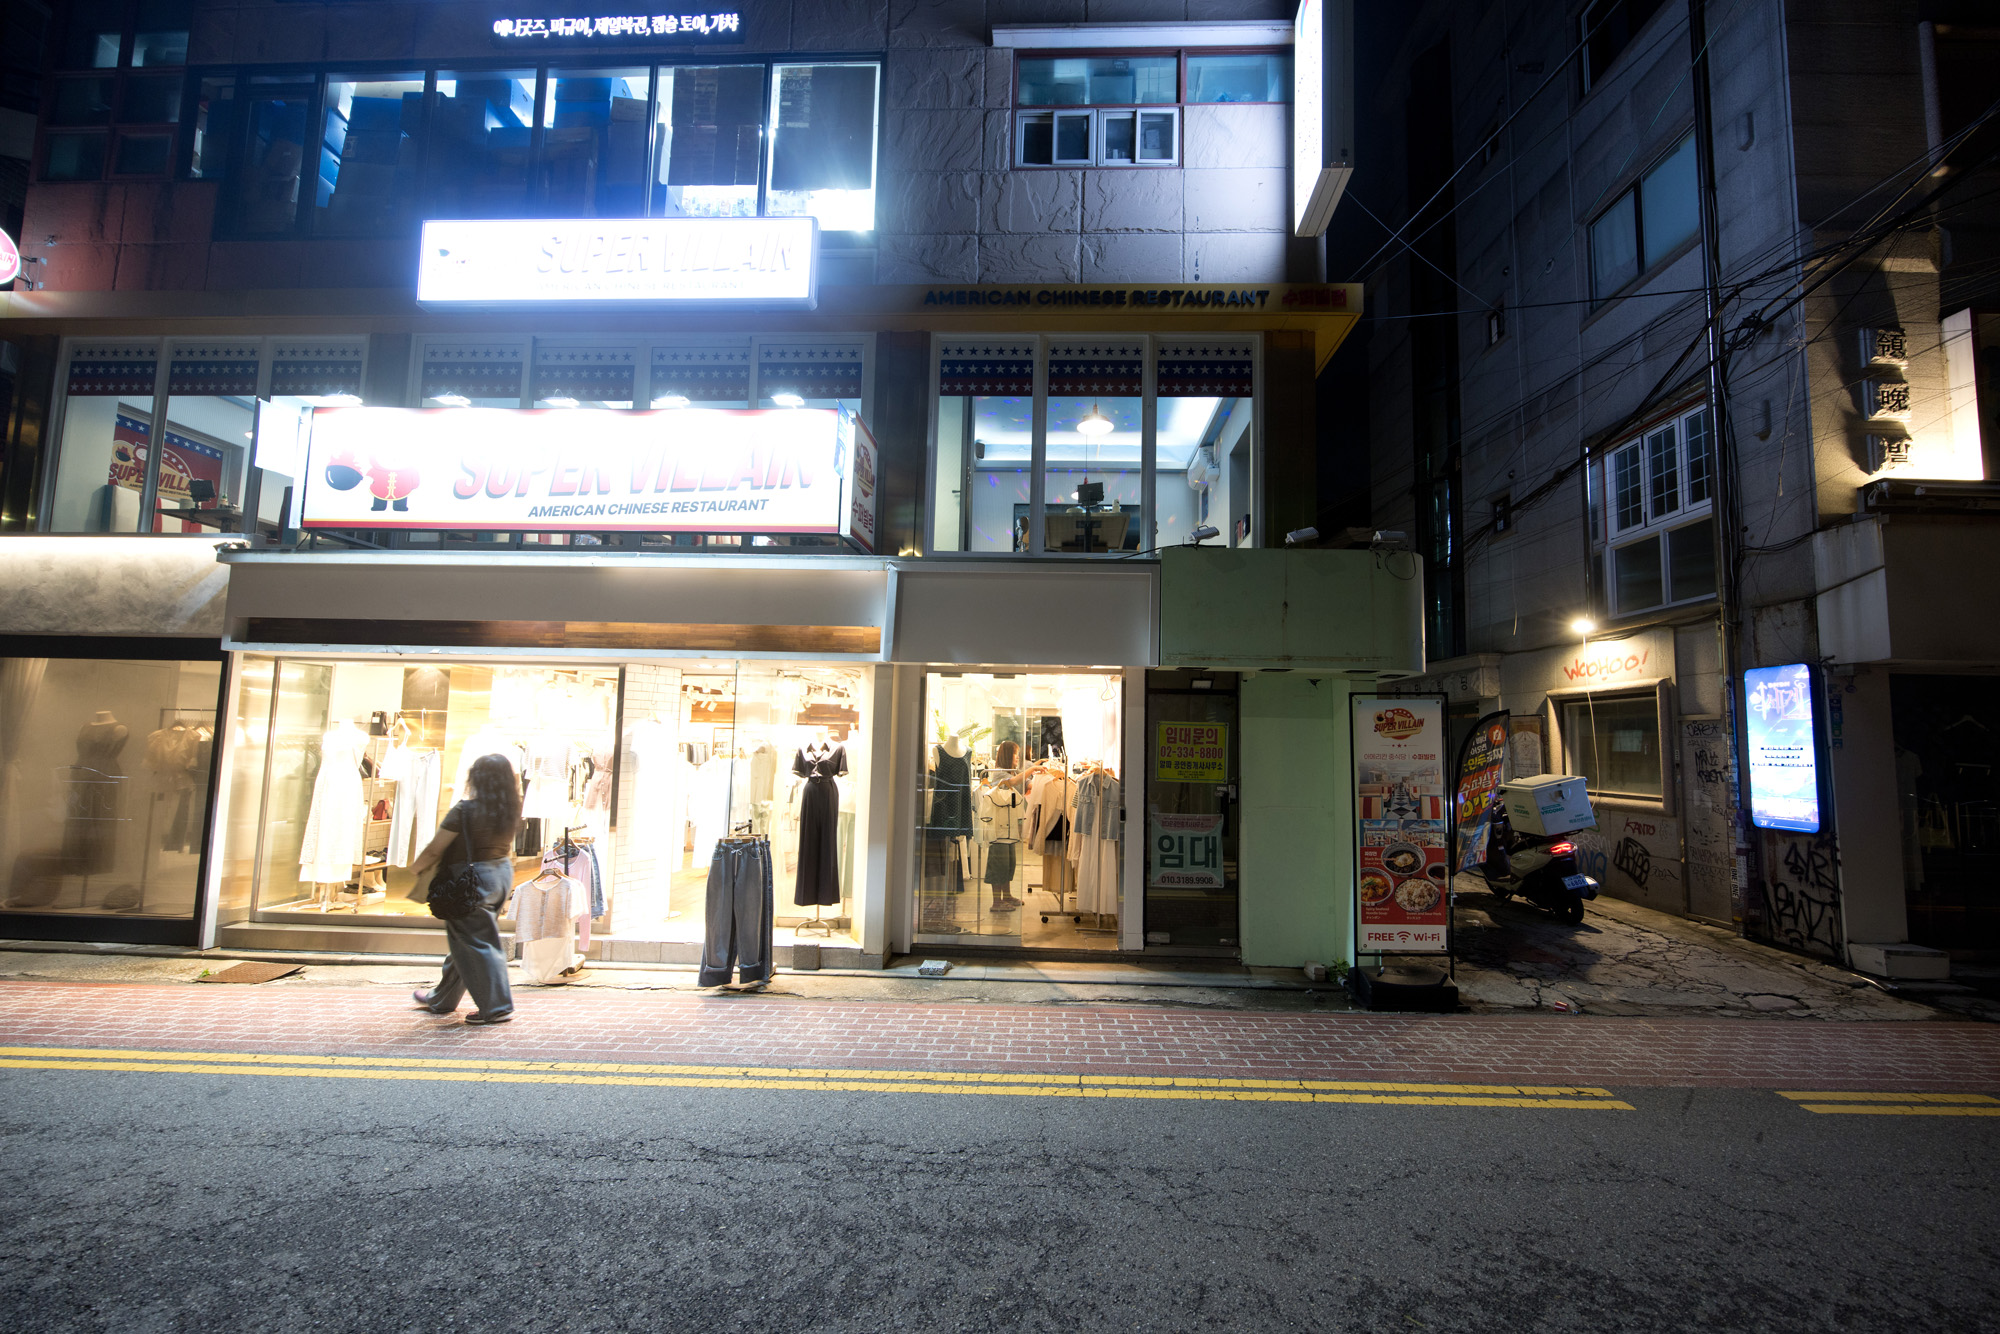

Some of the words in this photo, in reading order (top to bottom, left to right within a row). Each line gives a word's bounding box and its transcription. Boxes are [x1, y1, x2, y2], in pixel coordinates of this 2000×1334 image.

[924, 290, 1030, 306] AMERICAN
[1037, 290, 1127, 306] CHINESE
[1132, 289, 1269, 307] RESTAURANT
[108, 463, 145, 483] SUPE
[453, 448, 614, 499] SUPER
[630, 439, 813, 496] VILLAIN
[528, 502, 605, 517] AMERICAN
[607, 501, 670, 515] CHINESE
[671, 499, 769, 514] RESTAURANT
[1563, 651, 1648, 680] WOOHOO!
[1374, 721, 1397, 732] SUPER
[1398, 718, 1424, 730] VILLAIN
[1166, 727, 1218, 745] 임대문의
[1160, 745, 1223, 759] 02-334-8800
[1158, 835, 1217, 868] 임대
[1161, 876, 1214, 885] 010.3189.9908
[1368, 933, 1394, 941] FREE
[1413, 933, 1440, 941] Wi-Fi
